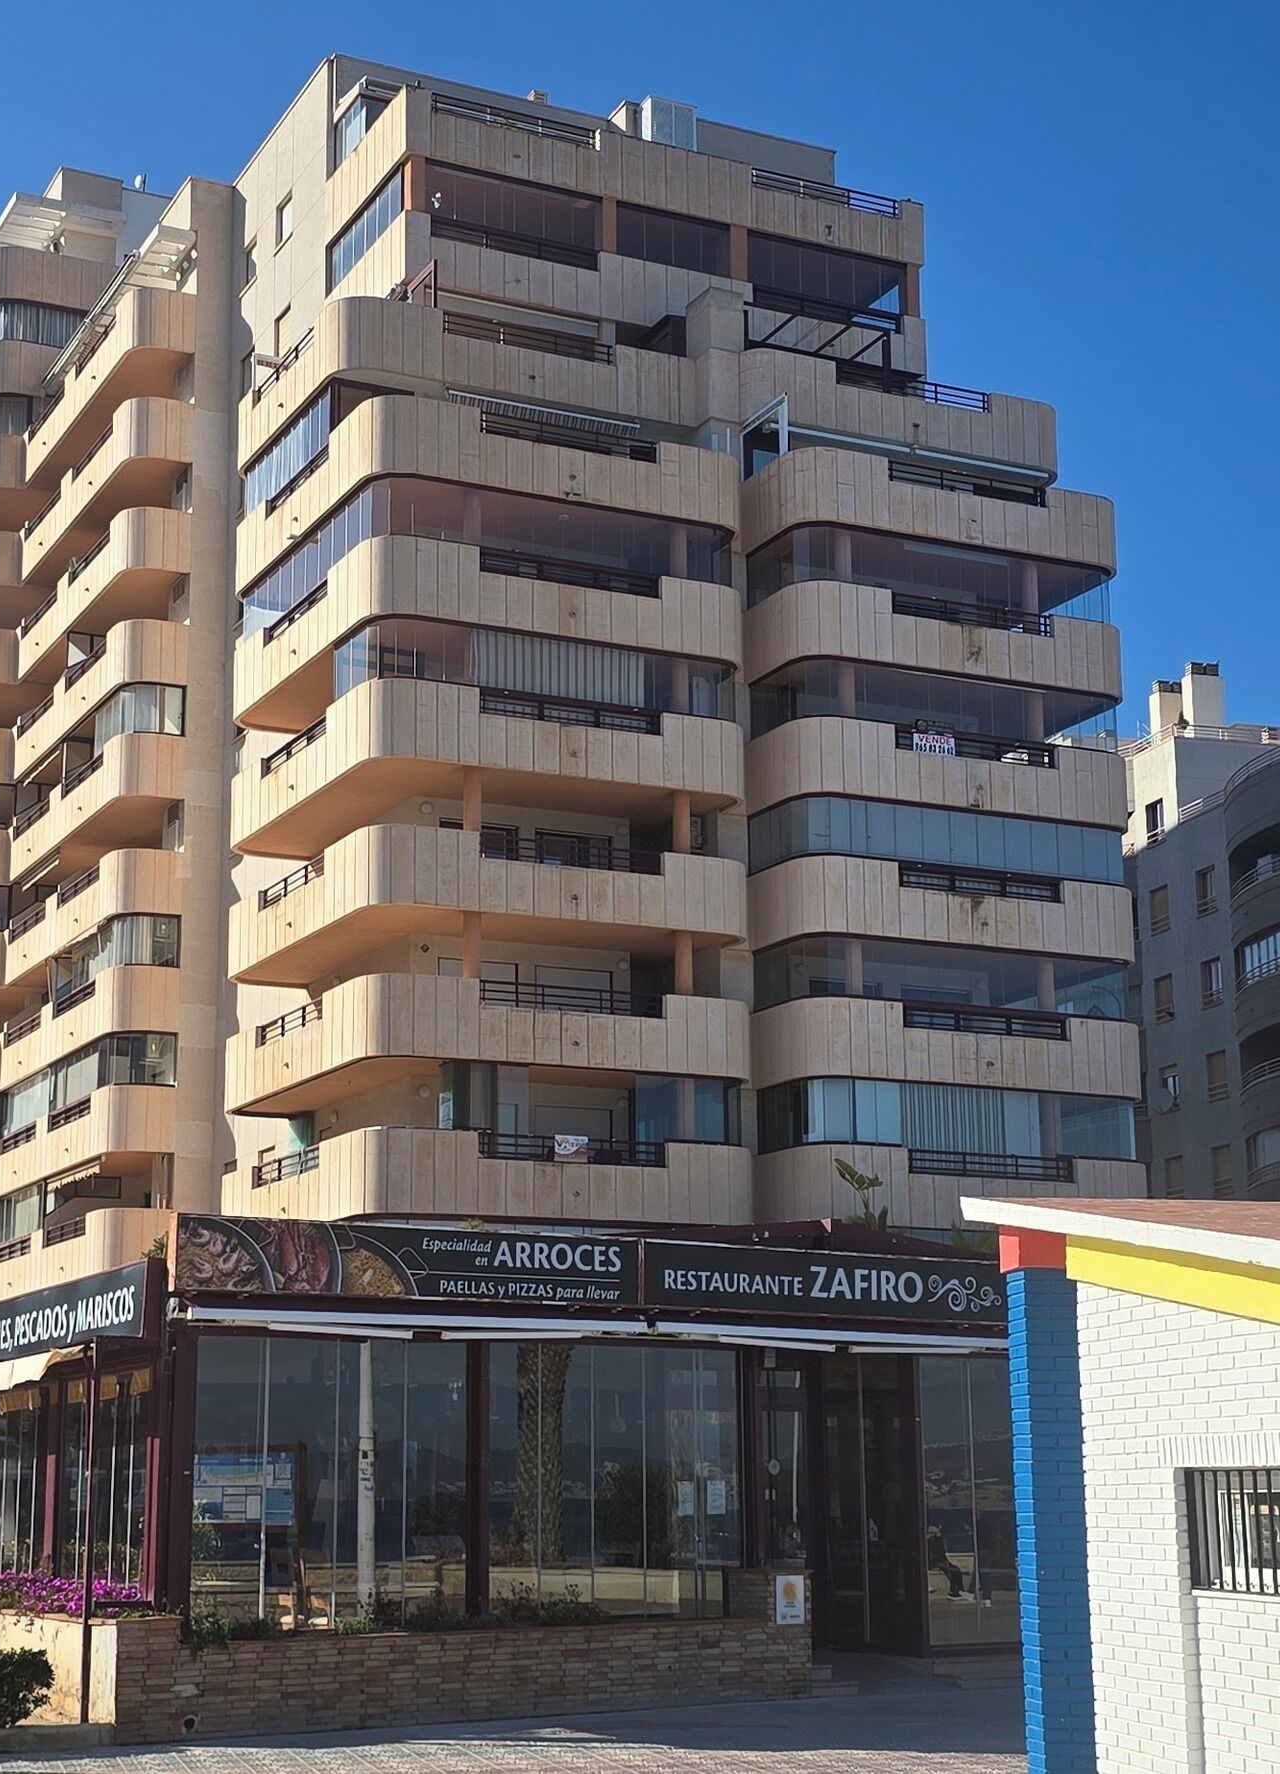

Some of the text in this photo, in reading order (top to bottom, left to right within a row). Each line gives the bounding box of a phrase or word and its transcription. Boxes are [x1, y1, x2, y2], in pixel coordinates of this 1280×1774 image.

[918, 735, 952, 746] VENDE
[422, 1237, 492, 1253] Especialidad
[475, 1241, 621, 1273] en ARROCES
[439, 1280, 620, 1301] PAELLAS y PIZZAS para llevar
[664, 1266, 923, 1303] RESTAURANTE ZAFIRO
[14, 1304, 68, 1347] PESCADOS
[69, 1310, 77, 1343] y
[75, 1285, 135, 1333] MARISCOS
